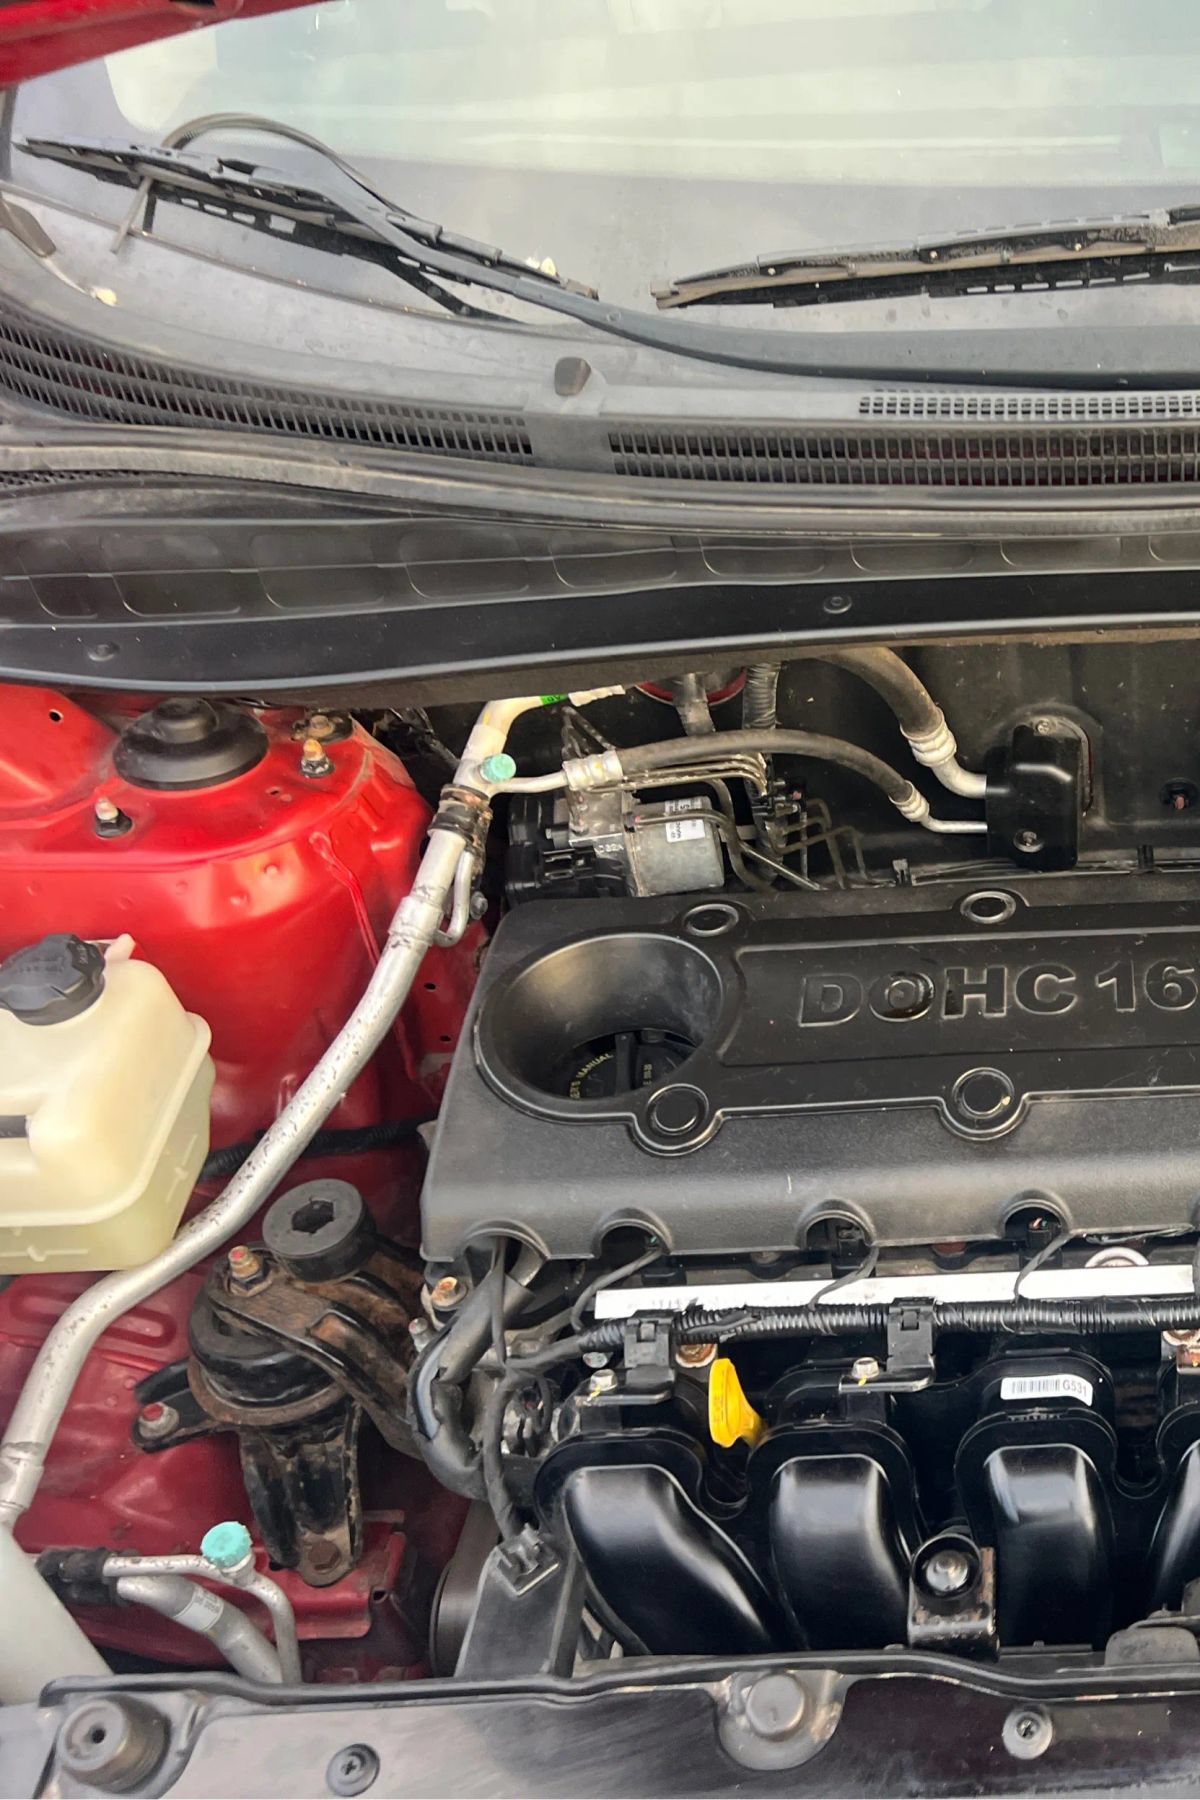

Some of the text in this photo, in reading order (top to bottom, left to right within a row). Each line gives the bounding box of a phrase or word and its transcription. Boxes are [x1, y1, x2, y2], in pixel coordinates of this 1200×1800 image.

[798, 961, 1078, 1027] DOHC
[575, 1052, 614, 1079] MANUAL
[1062, 1378, 1088, 1398] G531
